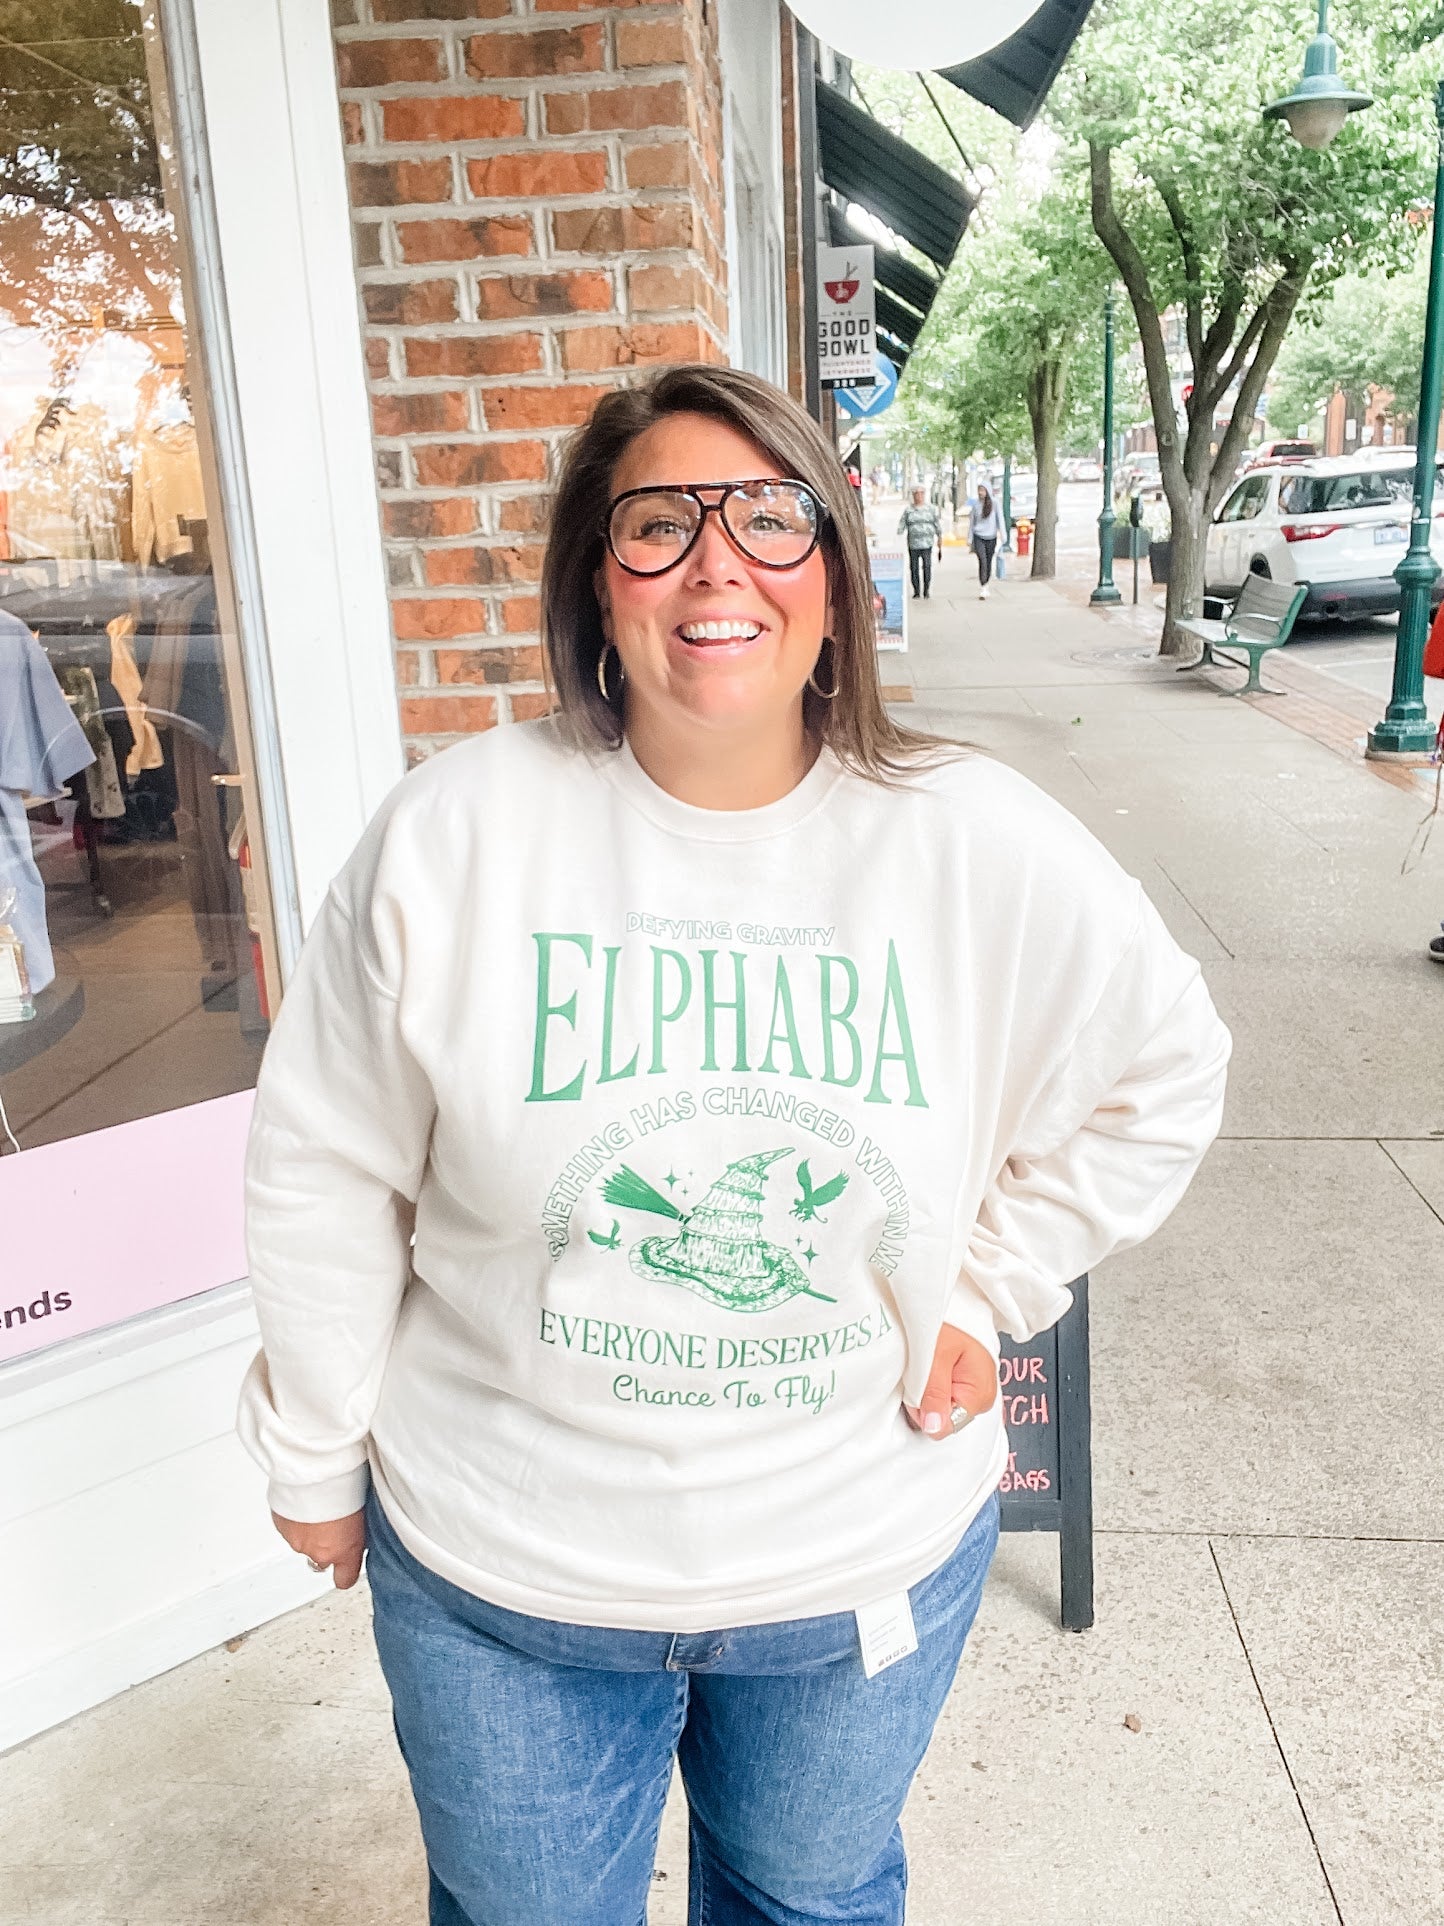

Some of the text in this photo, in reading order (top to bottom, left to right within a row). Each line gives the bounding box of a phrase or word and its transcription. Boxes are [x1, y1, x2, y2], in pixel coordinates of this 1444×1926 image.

[818, 319, 870, 337] GOOD
[818, 339, 870, 357] BOWL
[626, 911, 835, 946] DEFYING GRAVITY
[525, 932, 930, 1109] ELPHABA
[541, 1121, 634, 1262] SOMETHING
[630, 1091, 697, 1137] HAS
[702, 1087, 855, 1147] CHANGED
[855, 1136, 910, 1240] WITHIN
[0, 1290, 72, 1329] nds
[539, 1302, 892, 1369] EVERYONE DESERVES A
[613, 1370, 836, 1415] Chance To Fly!
